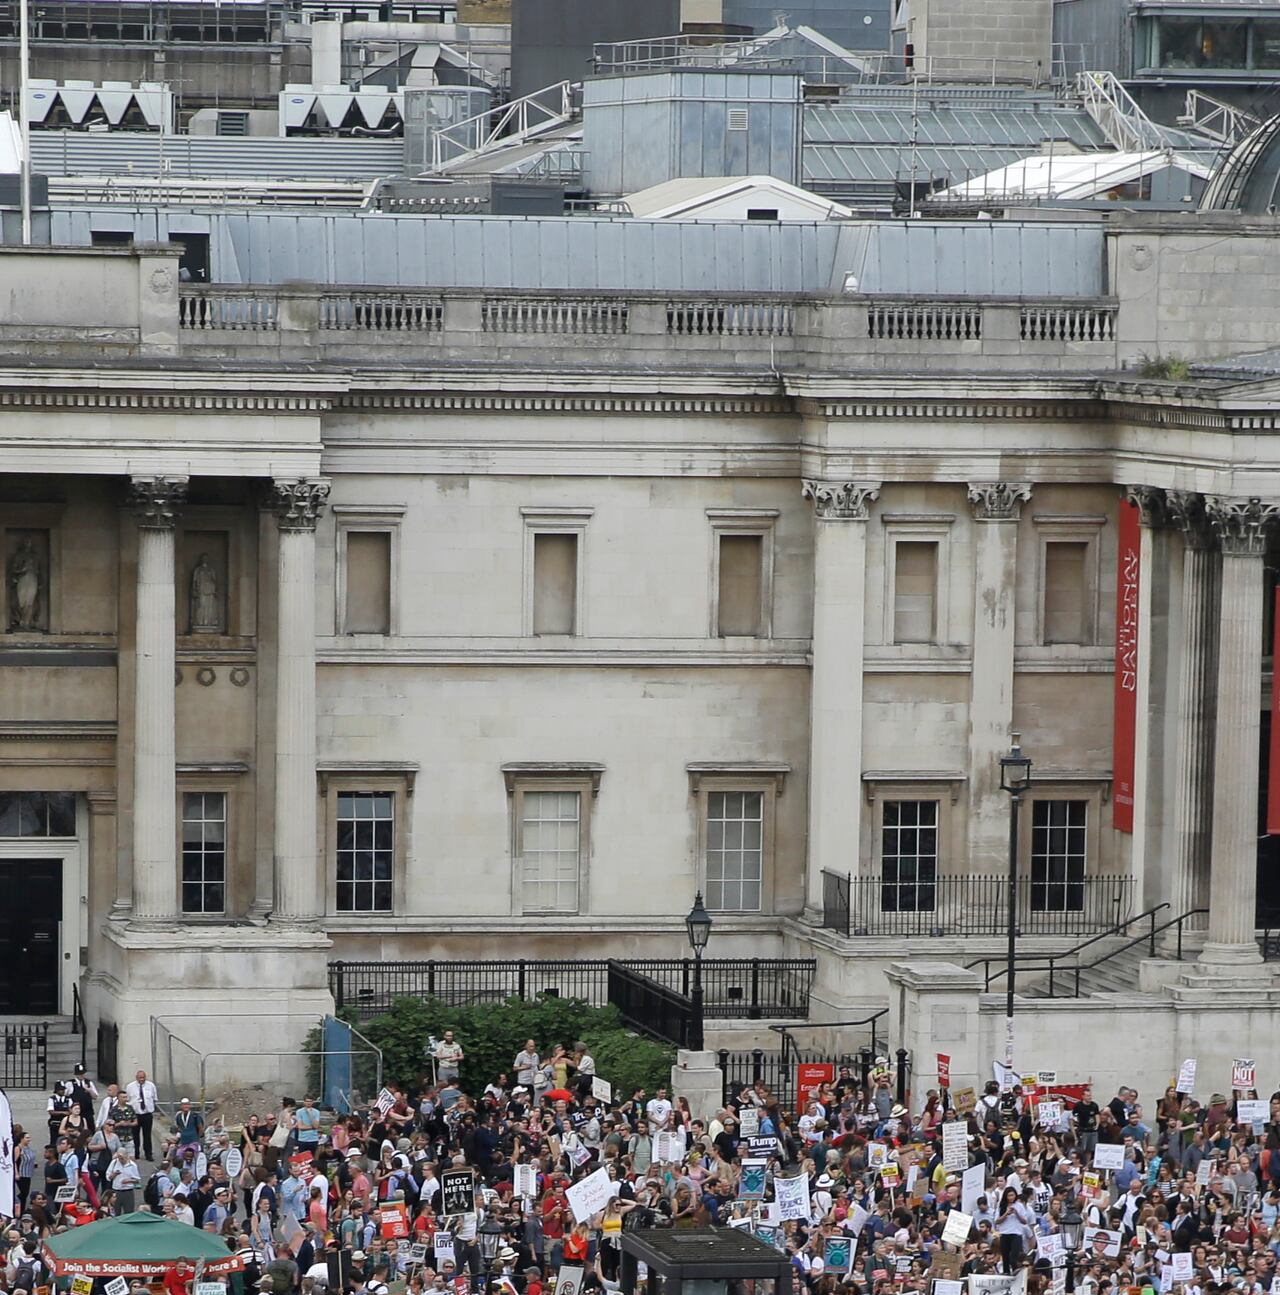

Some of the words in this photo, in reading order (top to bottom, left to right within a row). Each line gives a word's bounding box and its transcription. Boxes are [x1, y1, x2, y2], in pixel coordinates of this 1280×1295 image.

[1232, 1058, 1256, 1067] TRUMP
[1233, 1067, 1253, 1081] NOT
[747, 1136, 778, 1148] Trump
[446, 1177, 470, 1186] NOT
[444, 1184, 473, 1195] HERE
[436, 1240, 453, 1249] LOVE
[63, 1262, 82, 1273] Join
[85, 1263, 101, 1273] the
[102, 1262, 140, 1274] Socialist
[209, 1262, 230, 1273] here
